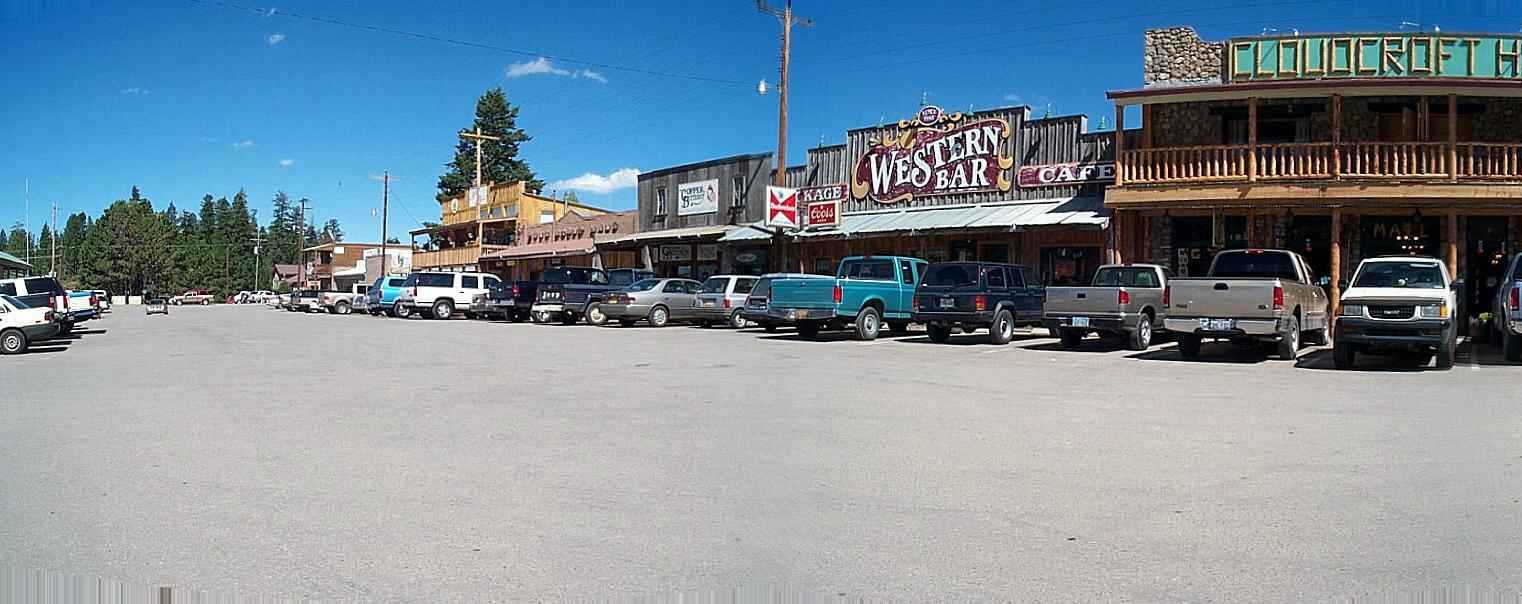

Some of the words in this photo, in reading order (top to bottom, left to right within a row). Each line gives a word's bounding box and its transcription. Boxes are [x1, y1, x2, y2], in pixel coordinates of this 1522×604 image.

[1233, 37, 1482, 77] CLOUDCROFT
[869, 127, 1001, 195] WESTERN
[935, 158, 991, 190] BAR
[1039, 164, 1116, 183] CAFE
[797, 186, 842, 201] KAGE
